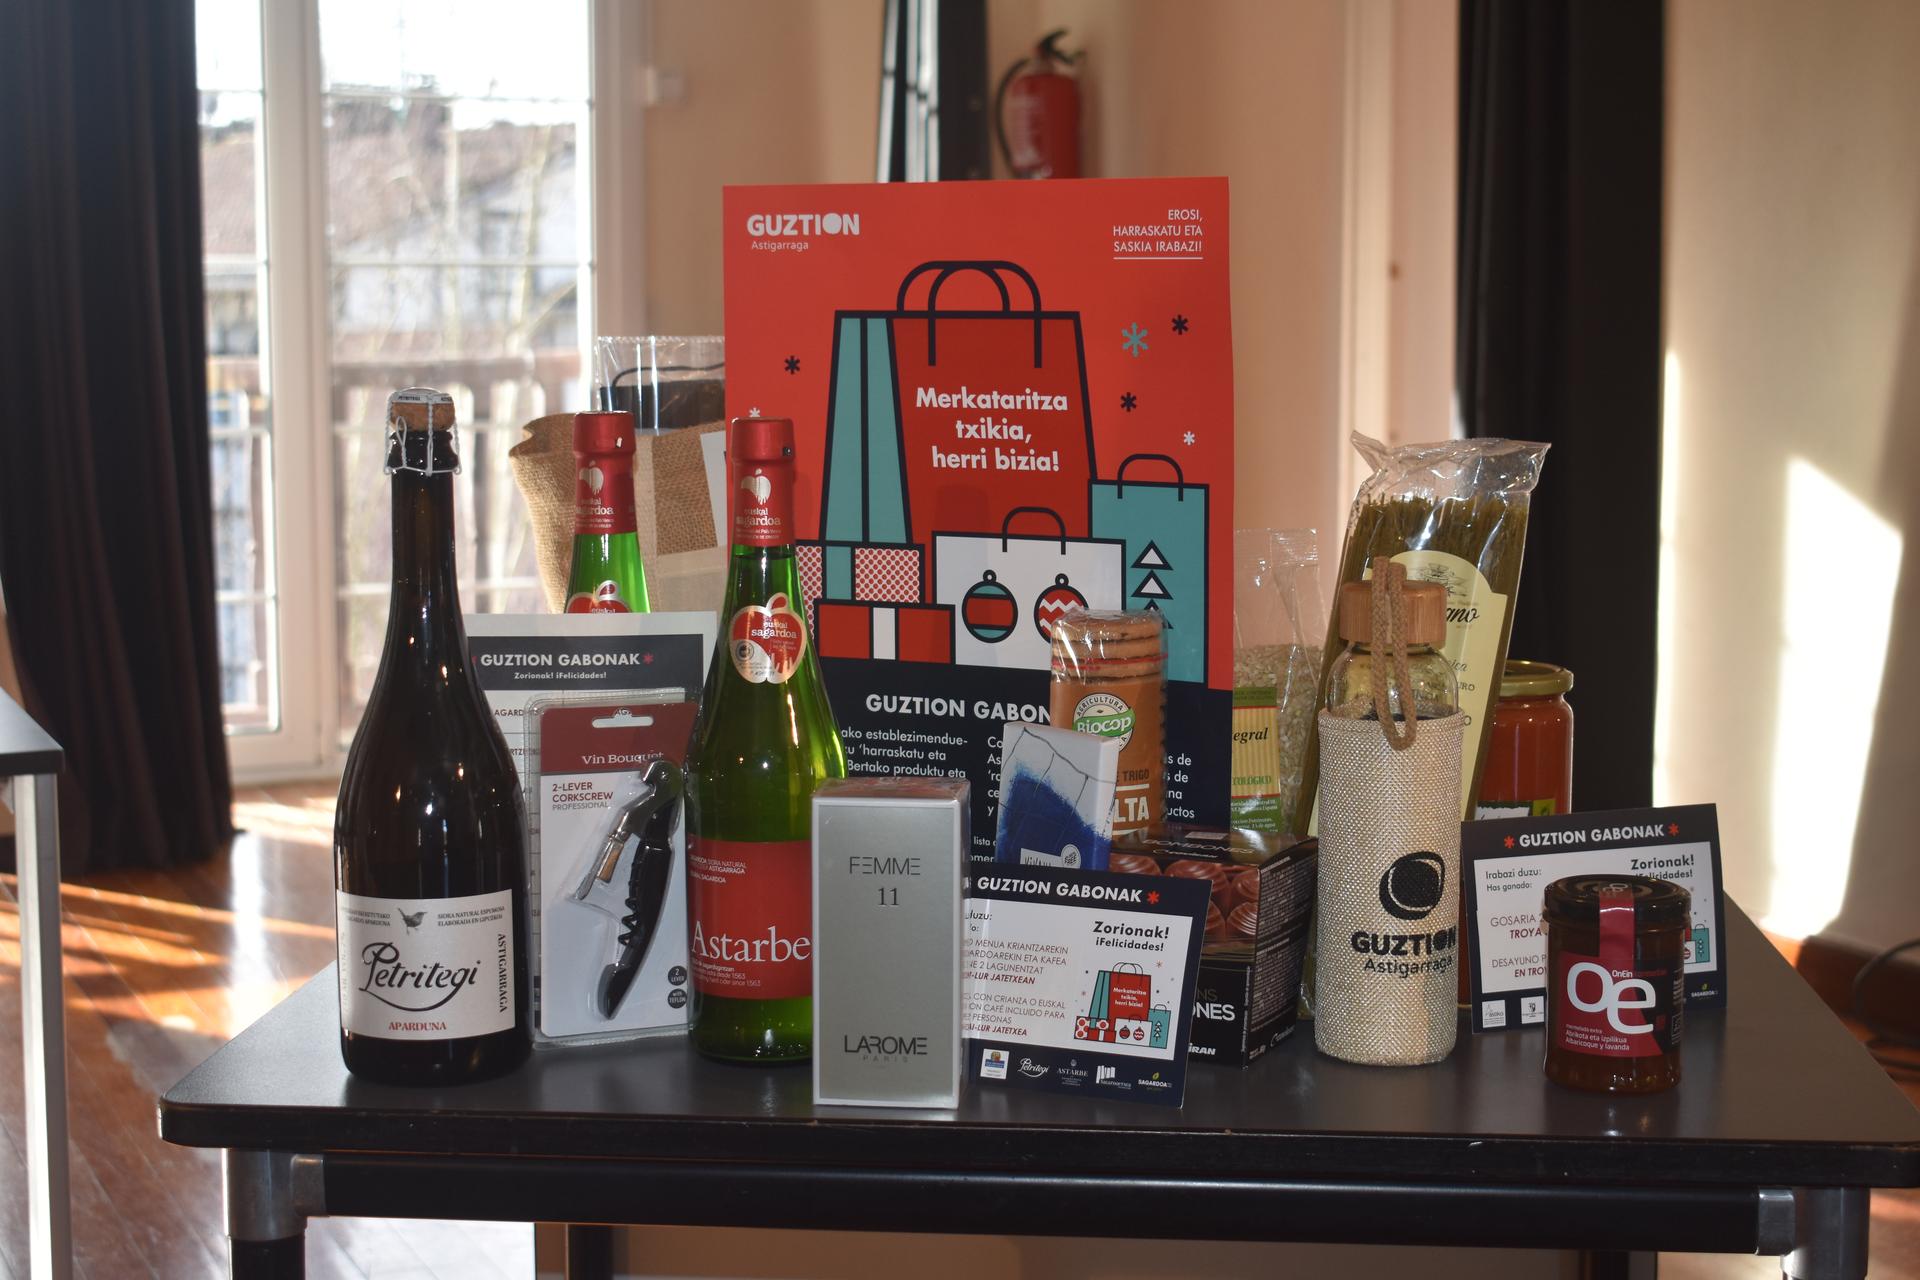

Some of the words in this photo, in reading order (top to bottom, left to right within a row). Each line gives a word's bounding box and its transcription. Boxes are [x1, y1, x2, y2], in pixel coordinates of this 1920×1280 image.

[1168, 209, 1203, 222] EROSI,
[746, 213, 860, 237] GUZTION
[1113, 225, 1181, 236] HARRASKATU
[1184, 225, 1203, 236] ETA
[751, 240, 809, 253] Astigarraga
[1113, 241, 1152, 252] SASKIA
[1156, 241, 1202, 252] IRABAZI!
[915, 386, 1068, 411] Merkataritza
[955, 418, 1032, 443] txikia,
[931, 445, 987, 470] herri
[995, 448, 1060, 472] bizia!
[1446, 607, 1480, 623] ano
[751, 629, 797, 639] sagardoa
[480, 654, 553, 666] GUZTION
[558, 653, 640, 666] GABONAK
[1451, 659, 1468, 672] ica
[514, 672, 554, 680] Zorionak!
[865, 694, 965, 717] GUZTION
[973, 702, 1050, 723] GABON
[1076, 696, 1124, 717] AGRICULTURA
[1077, 716, 1132, 734] Biocop
[841, 726, 862, 738] ako
[866, 729, 968, 745] establezimendue-
[1233, 728, 1269, 744] egral
[581, 754, 605, 764] Vin
[928, 750, 947, 761] eta
[1177, 753, 1192, 766] de
[848, 760, 889, 773] Bertako
[893, 763, 944, 777] produktu
[948, 768, 966, 778] eta
[1122, 769, 1150, 780] TRIGO
[1174, 770, 1189, 783] de
[552, 782, 593, 791] 2-LEVER
[552, 792, 614, 803] CORKSCREW
[552, 802, 609, 811] PROFESSIONAL
[987, 805, 994, 816] y
[1167, 807, 1195, 819] uctos
[974, 835, 990, 846] lista
[1519, 830, 1586, 847] GUZTION
[1591, 824, 1664, 842] GABONAK
[849, 856, 921, 875] FEMME
[1631, 854, 1695, 870] Zorionak!
[709, 866, 745, 874] ASTIGARRAGA
[1485, 869, 1515, 879] Irabazi
[1518, 868, 1542, 877] duzu:
[977, 876, 1051, 895] GUZTION
[1056, 883, 1143, 903] GABONAK
[1487, 883, 1501, 892] Has
[1502, 881, 1532, 892] ganado:
[877, 887, 900, 906] 11
[1490, 914, 1537, 927] GOSARIA
[1093, 920, 1169, 939] Zorionak!
[1510, 928, 1542, 939] TROYA
[691, 920, 811, 962] Astarbe
[975, 939, 1005, 948] MENUA
[1007, 942, 1069, 954] KRIANTZAREKIN
[1096, 937, 1164, 951] ¡Felicidades!
[1351, 925, 1457, 956] GUZTION
[969, 950, 1021, 961] ARDOAREKIN
[1024, 954, 1038, 963] ETA
[1040, 956, 1067, 965] KAFEA
[1491, 954, 1540, 968] DESAYUNO
[497, 933, 508, 1013] ASTIGARRAGA
[675, 968, 680, 976] 2
[986, 962, 1044, 975] LAGUNENTZAT
[1364, 956, 1452, 979] Astigarraga
[1514, 969, 1526, 977] EN
[359, 942, 481, 1012] Petritegi
[990, 973, 1035, 984] JATETXEAN
[973, 993, 993, 1001] CON
[994, 995, 1028, 1005] CRIANZA
[1038, 999, 1066, 1009] EUSKAL
[983, 1004, 1004, 1012] CAFÉ
[1005, 1007, 1042, 1017] INCLUIDO
[1044, 1011, 1065, 1019] PARA
[972, 1013, 1012, 1024] PERSONAS
[388, 1021, 447, 1031] APARDUNA
[968, 1023, 991, 1032] AI-LUR
[992, 1026, 1028, 1036] JATETXEA
[1566, 1030, 1589, 1039] Abrikota
[844, 1035, 928, 1055] LAROME
[1605, 1043, 1630, 1051] lavanda
[863, 1055, 908, 1063] PARIS
[1057, 1068, 1089, 1077] ASTARBE
